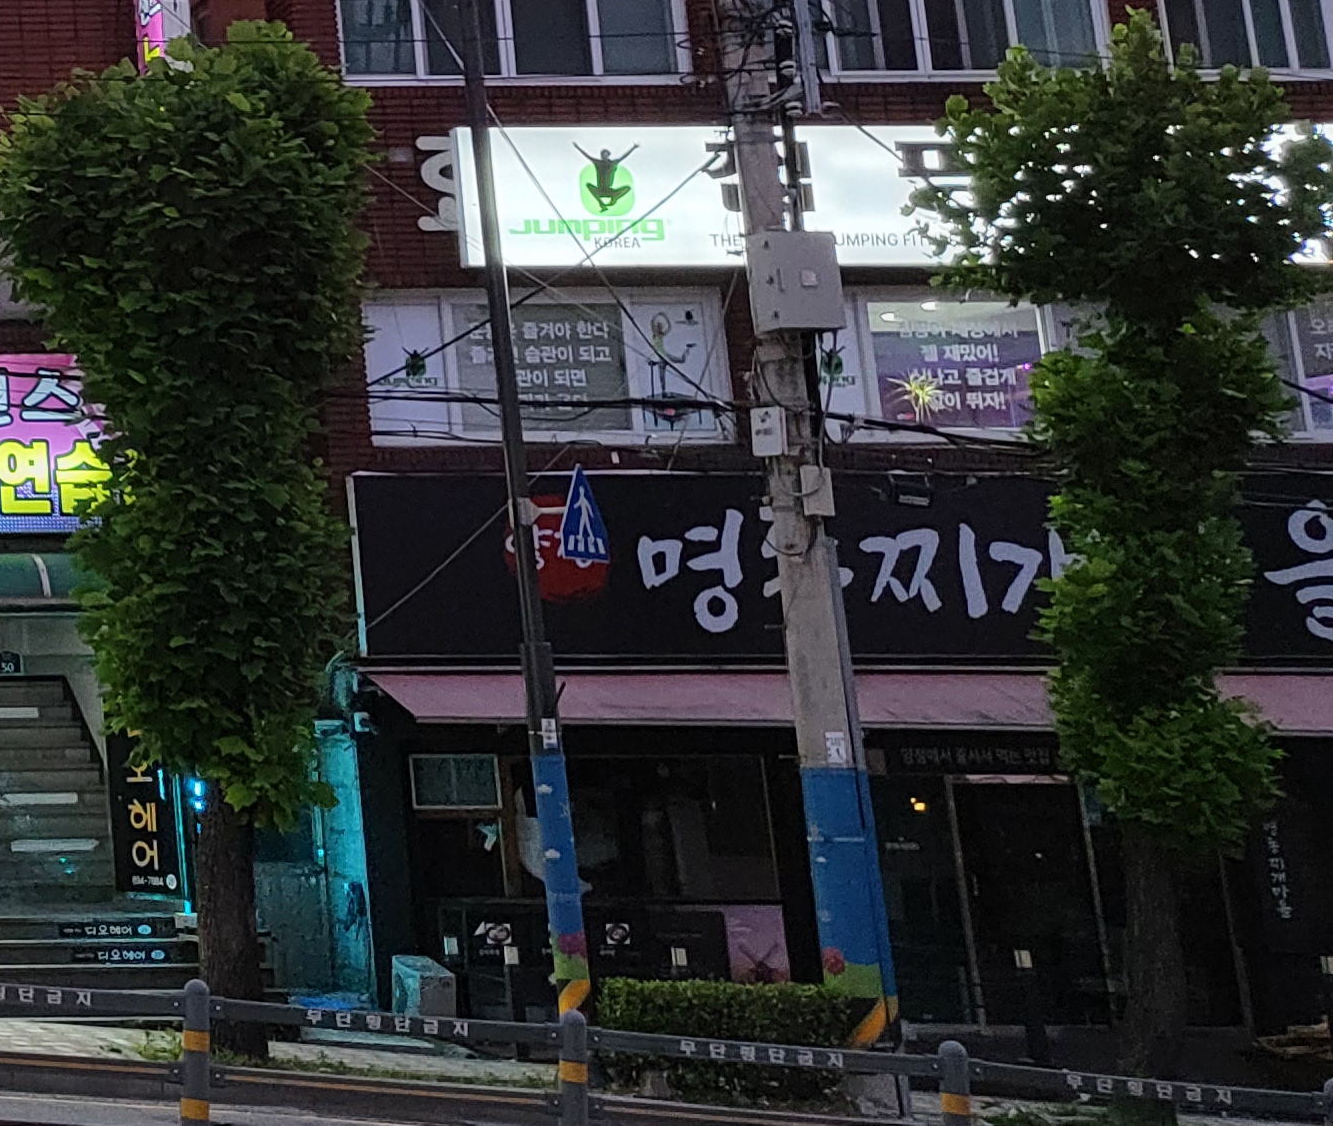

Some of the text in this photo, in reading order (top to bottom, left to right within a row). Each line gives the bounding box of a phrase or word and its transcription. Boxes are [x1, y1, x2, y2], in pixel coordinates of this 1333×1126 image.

[594, 236, 641, 249] KOREA
[834, 233, 899, 247] UMPING
[524, 344, 574, 365] 습관이
[577, 345, 613, 364] 되고
[514, 368, 589, 388] 관이 되면
[965, 366, 1018, 386] 즐겁게
[0, 661, 15, 673] 50
[126, 729, 159, 871] 오헤어
[84, 924, 133, 936] 디오헤어
[97, 948, 146, 961] 디오헤어
